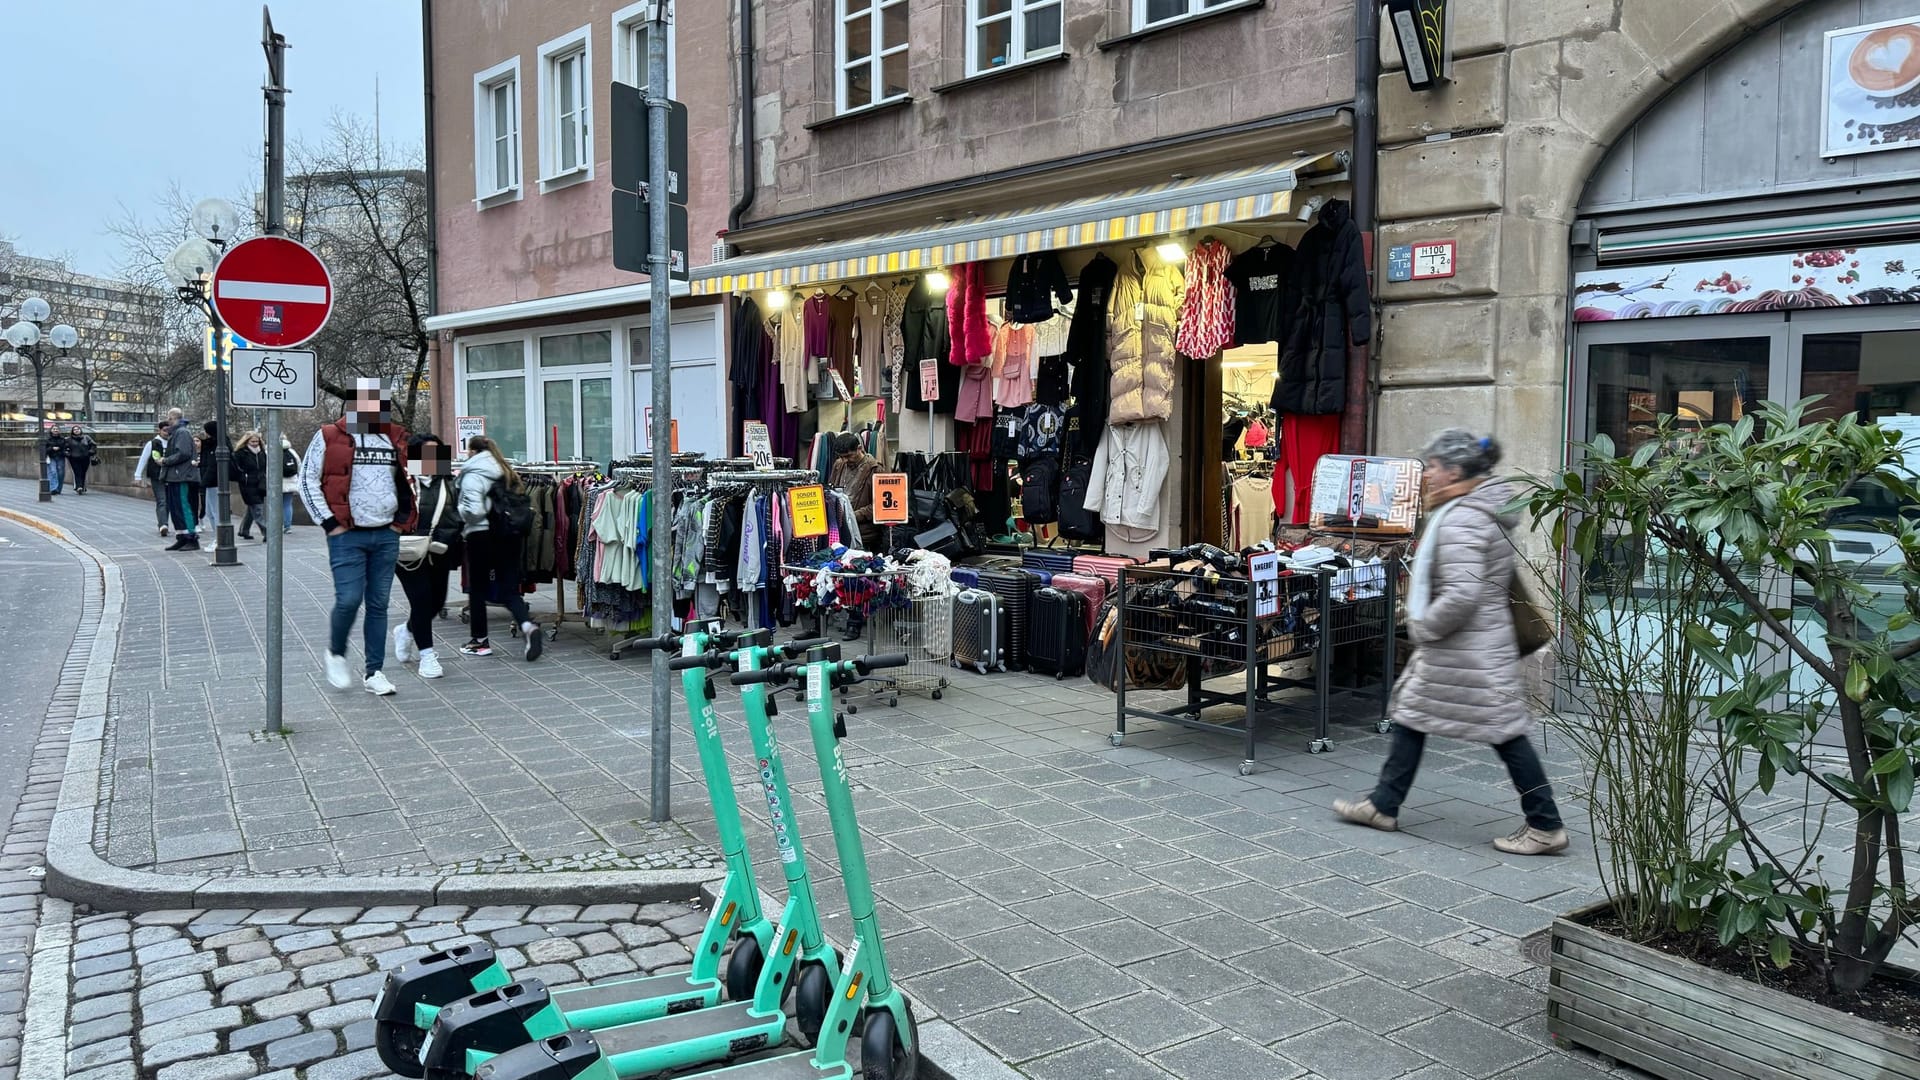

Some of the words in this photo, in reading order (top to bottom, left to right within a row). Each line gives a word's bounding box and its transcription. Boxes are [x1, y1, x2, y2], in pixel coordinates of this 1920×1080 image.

[261, 387, 287, 400] frei
[753, 450, 772, 466] 20€
[701, 704, 717, 739] Bolt
[832, 744, 847, 784] Bolt
